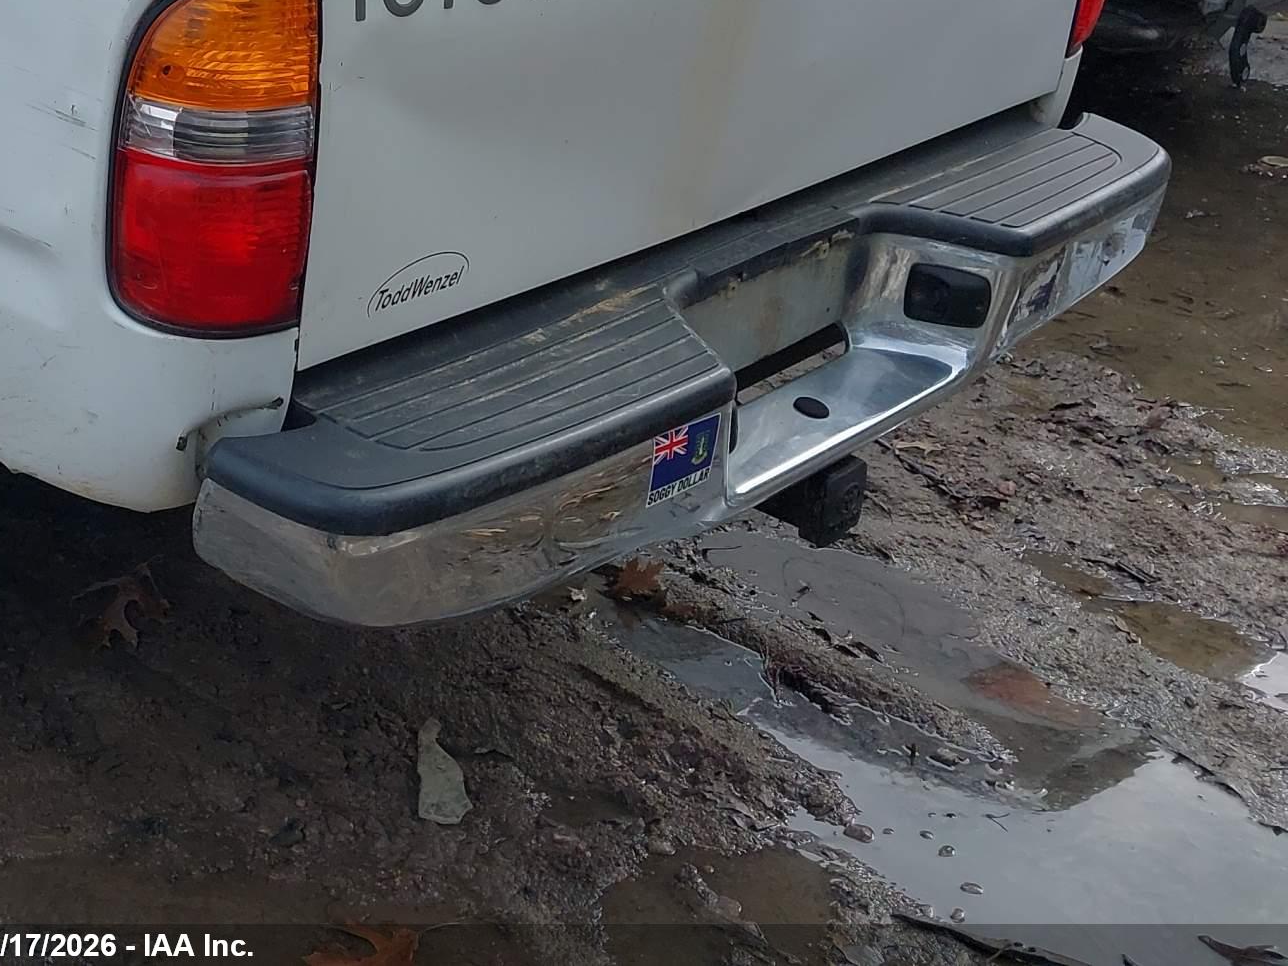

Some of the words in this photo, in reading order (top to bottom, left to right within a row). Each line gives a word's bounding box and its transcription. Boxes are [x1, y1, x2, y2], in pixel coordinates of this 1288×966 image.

[375, 265, 465, 312] ToddWenzel
[647, 484, 678, 506] SOGGY
[677, 467, 711, 493] DOLLAR
